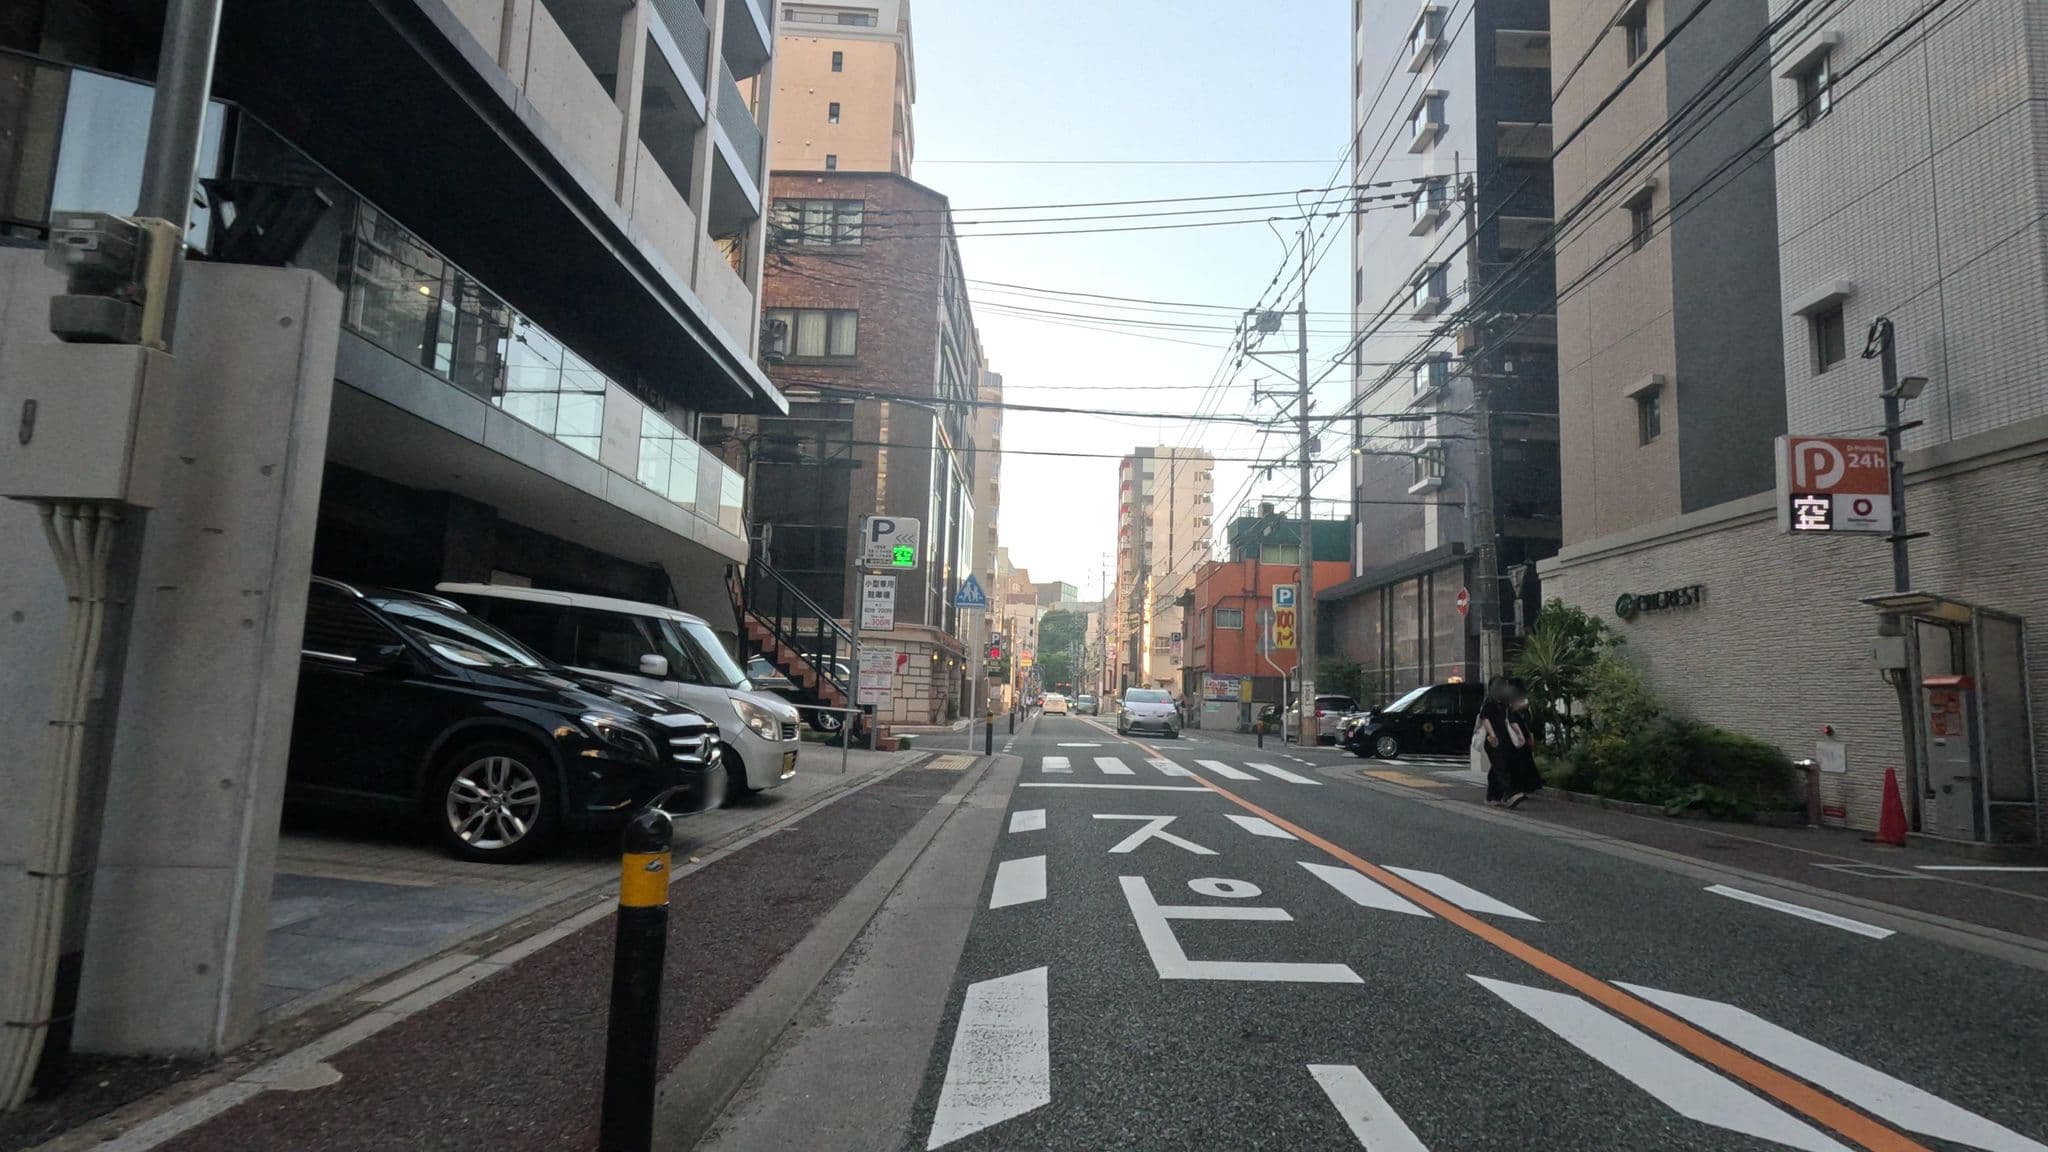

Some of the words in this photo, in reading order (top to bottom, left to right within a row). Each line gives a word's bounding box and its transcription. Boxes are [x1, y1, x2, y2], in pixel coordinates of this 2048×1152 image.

[1848, 453, 1885, 468] 24h
[1794, 495, 1830, 530] 空
[872, 519, 895, 542] P
[865, 580, 894, 589] 小型専用
[868, 591, 891, 600] 駐車場
[1279, 588, 1292, 603] P
[991, 633, 1000, 645] P
